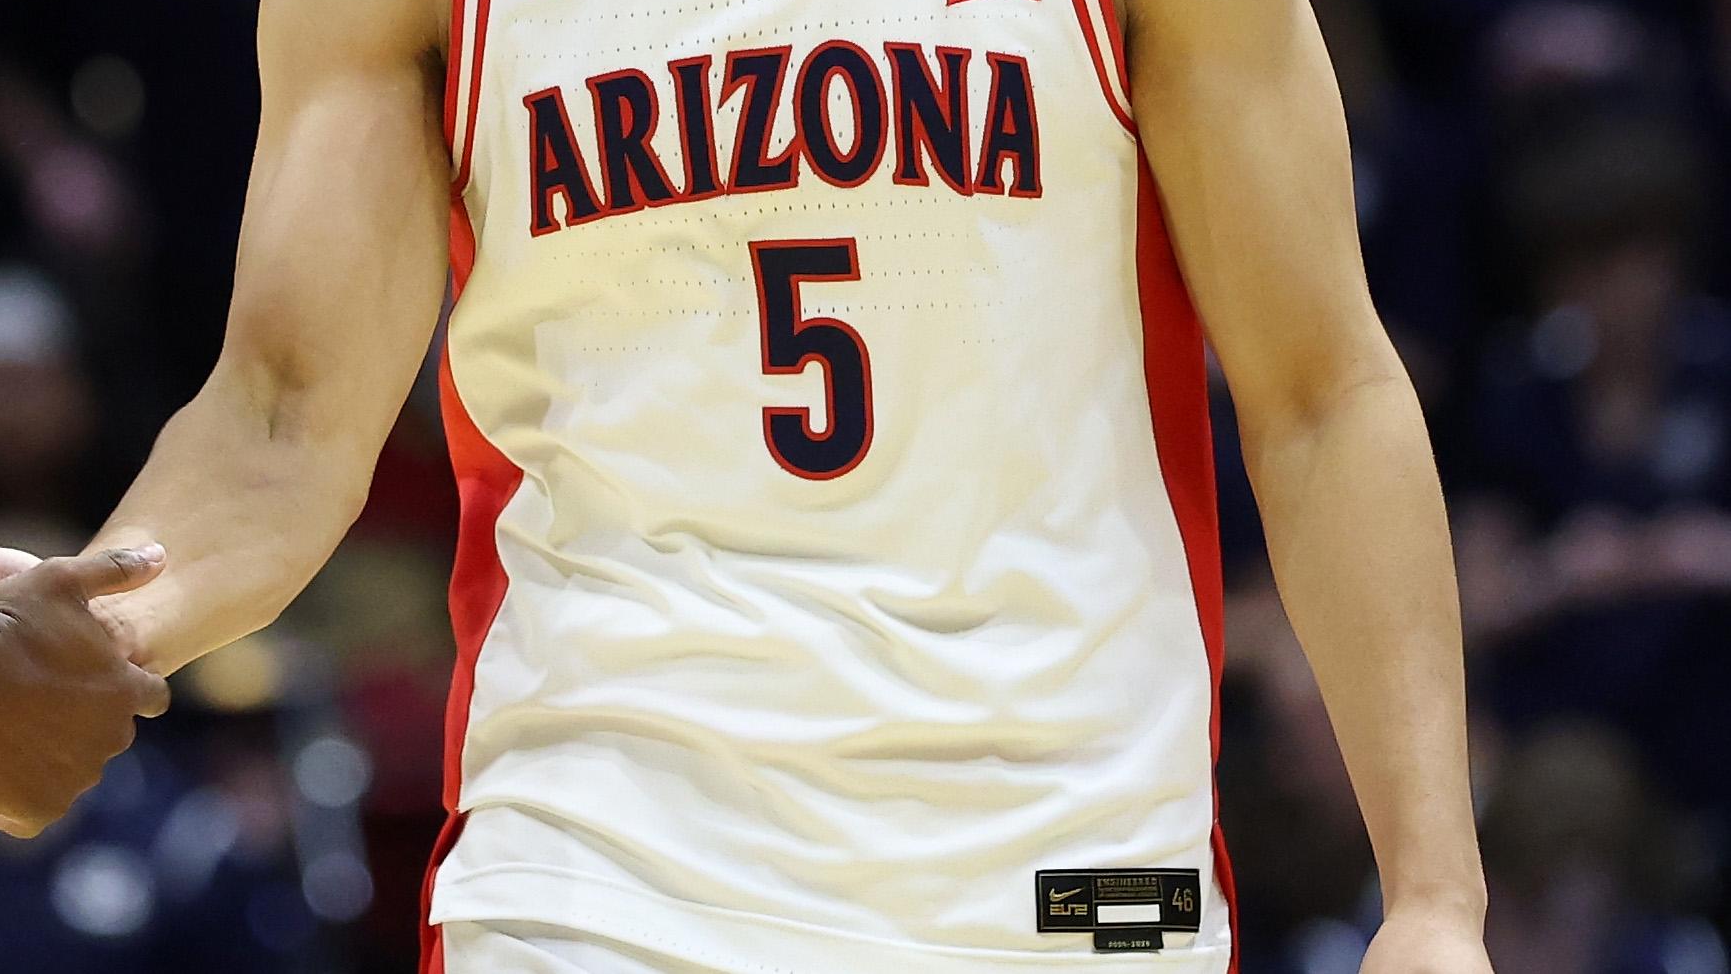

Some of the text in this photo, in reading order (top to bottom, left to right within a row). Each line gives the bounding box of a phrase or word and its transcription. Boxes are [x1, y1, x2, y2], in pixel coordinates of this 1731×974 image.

[522, 39, 1042, 237] ARIZONA
[748, 236, 874, 481] 5
[1172, 887, 1194, 913] 46
